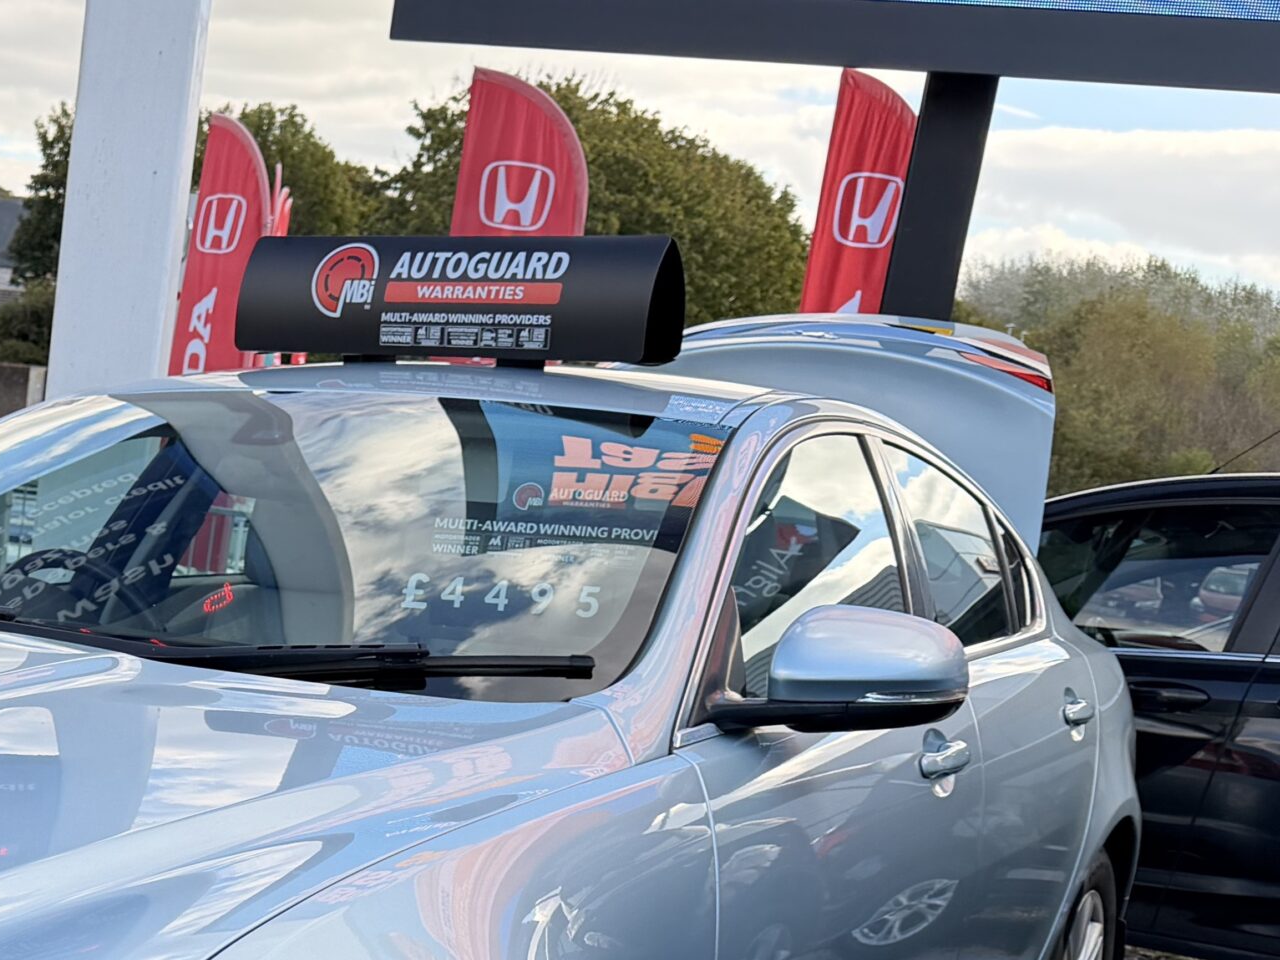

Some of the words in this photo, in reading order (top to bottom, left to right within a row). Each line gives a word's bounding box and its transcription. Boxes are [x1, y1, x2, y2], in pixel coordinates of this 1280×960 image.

[389, 251, 570, 280] AUTOGUARD
[416, 285, 525, 300] WARRANTIES
[381, 312, 448, 324] MULTI-AWARD
[448, 313, 494, 325] WINNING
[494, 314, 552, 326] PROVIDERS
[550, 487, 629, 502] AUTOGUARD
[434, 517, 538, 534] MULTI-AWARD
[539, 522, 609, 538] WINNING
[432, 543, 479, 555] WINNER
